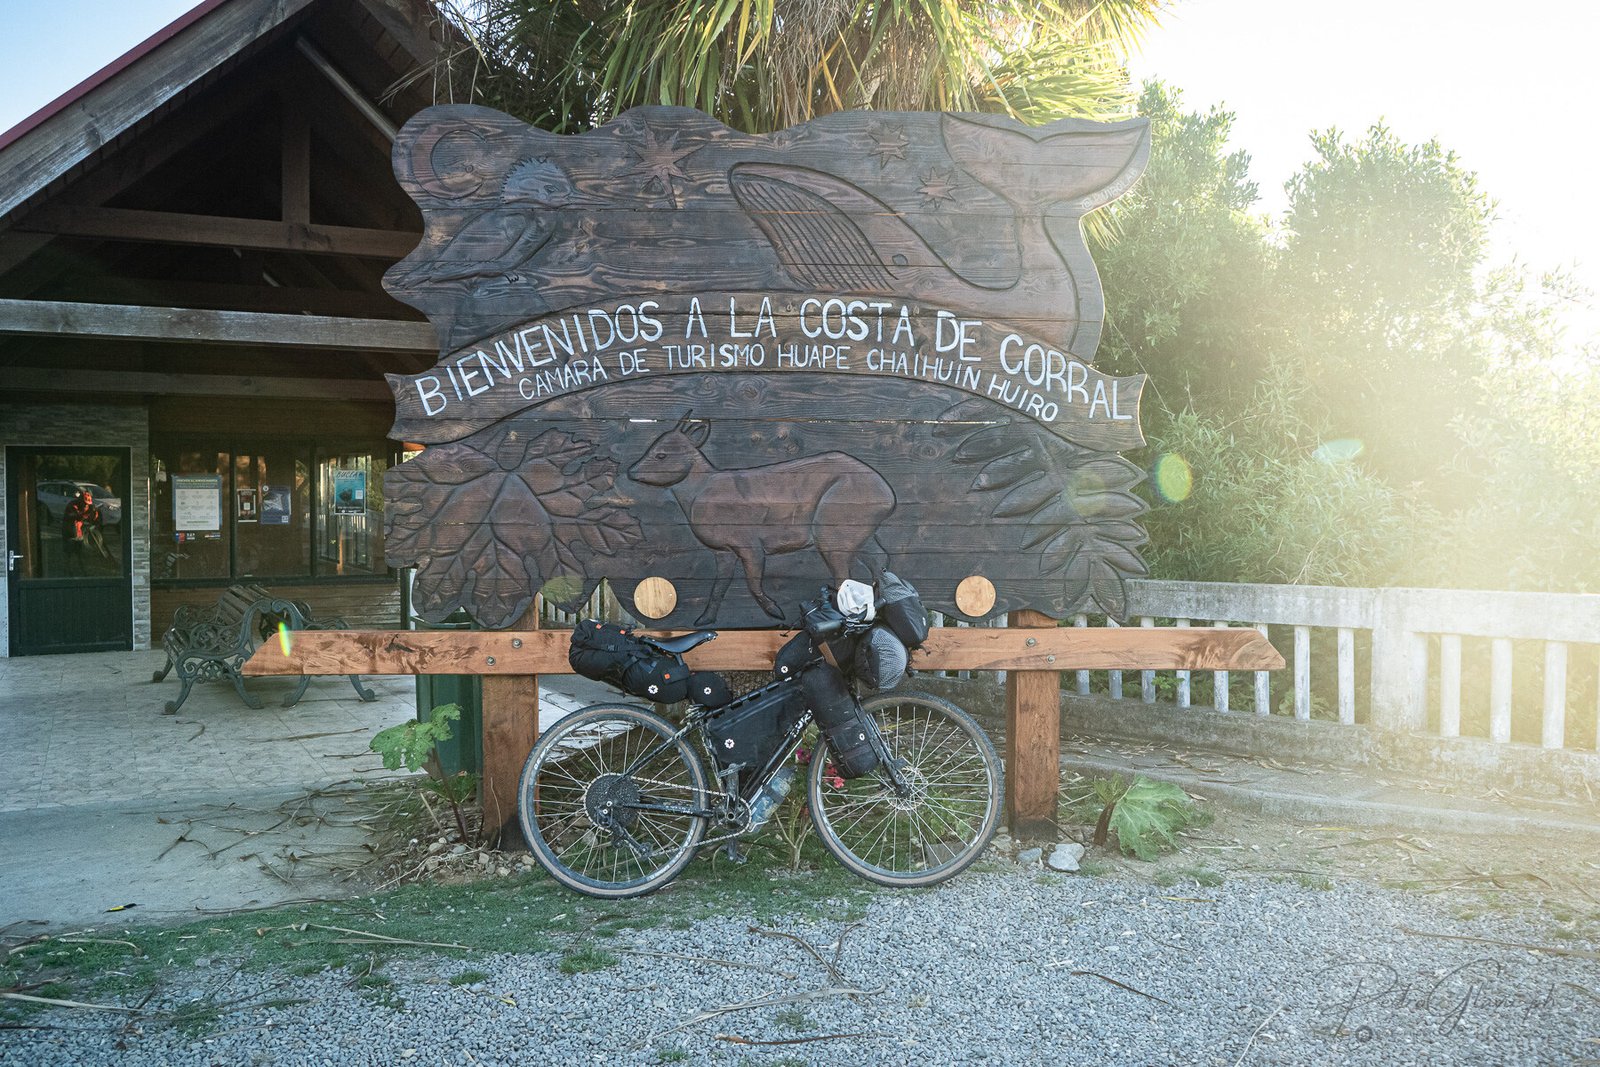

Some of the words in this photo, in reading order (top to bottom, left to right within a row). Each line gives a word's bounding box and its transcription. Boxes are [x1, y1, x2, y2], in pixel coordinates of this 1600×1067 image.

[414, 300, 664, 417] BIENVENIDOS
[685, 296, 708, 339] A
[730, 296, 777, 339] LA
[799, 298, 915, 347] COSTA
[935, 310, 983, 362] DE
[1000, 333, 1133, 420] CORRAL
[518, 355, 608, 400] CAMARA
[619, 348, 651, 376] DE
[662, 342, 765, 371] TURISMO
[777, 344, 852, 370] HUAPE
[866, 348, 982, 391] CHAIHUIN
[987, 373, 1059, 422] HUIRO
